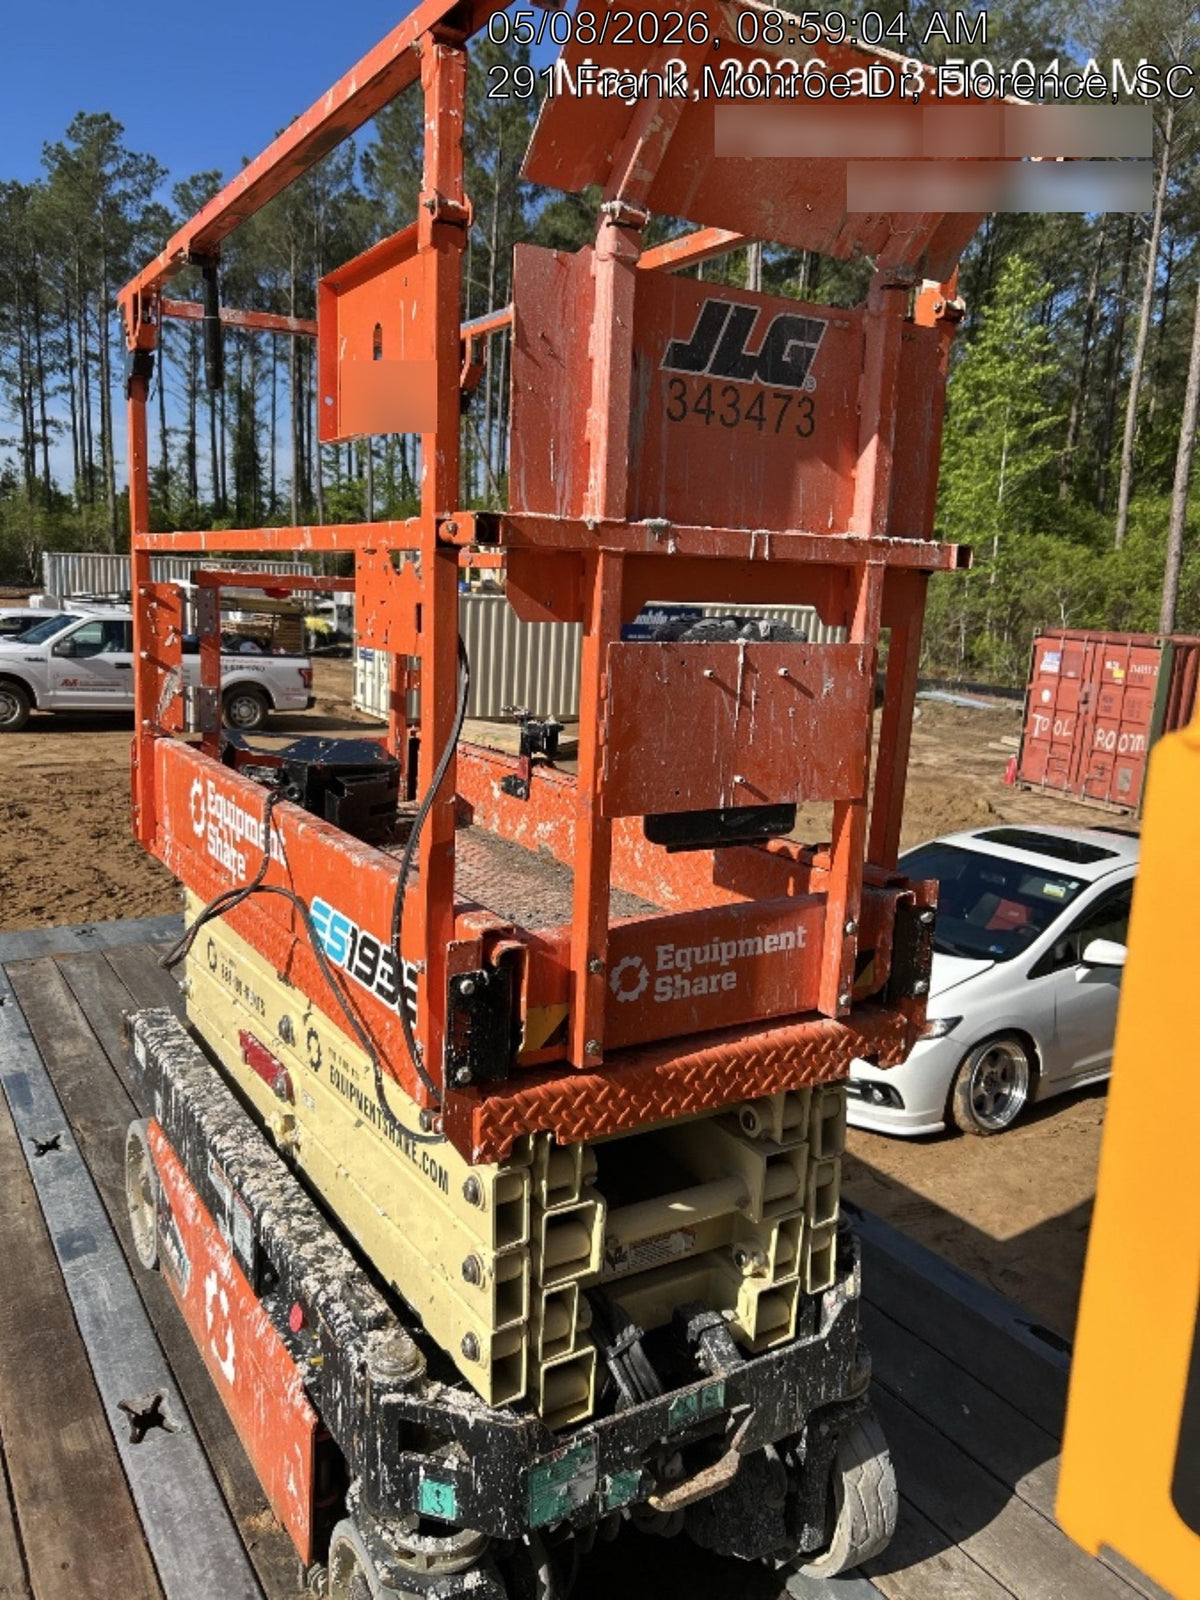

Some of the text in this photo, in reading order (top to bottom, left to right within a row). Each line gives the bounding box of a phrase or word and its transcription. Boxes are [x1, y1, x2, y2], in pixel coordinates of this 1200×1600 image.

[658, 298, 829, 391] JLG
[666, 377, 816, 438] 343473
[1094, 728, 1146, 753] ROOM
[207, 779, 288, 870] Equipment
[207, 821, 247, 886] Share
[655, 925, 808, 973] Equipment
[653, 970, 738, 1003] Share
